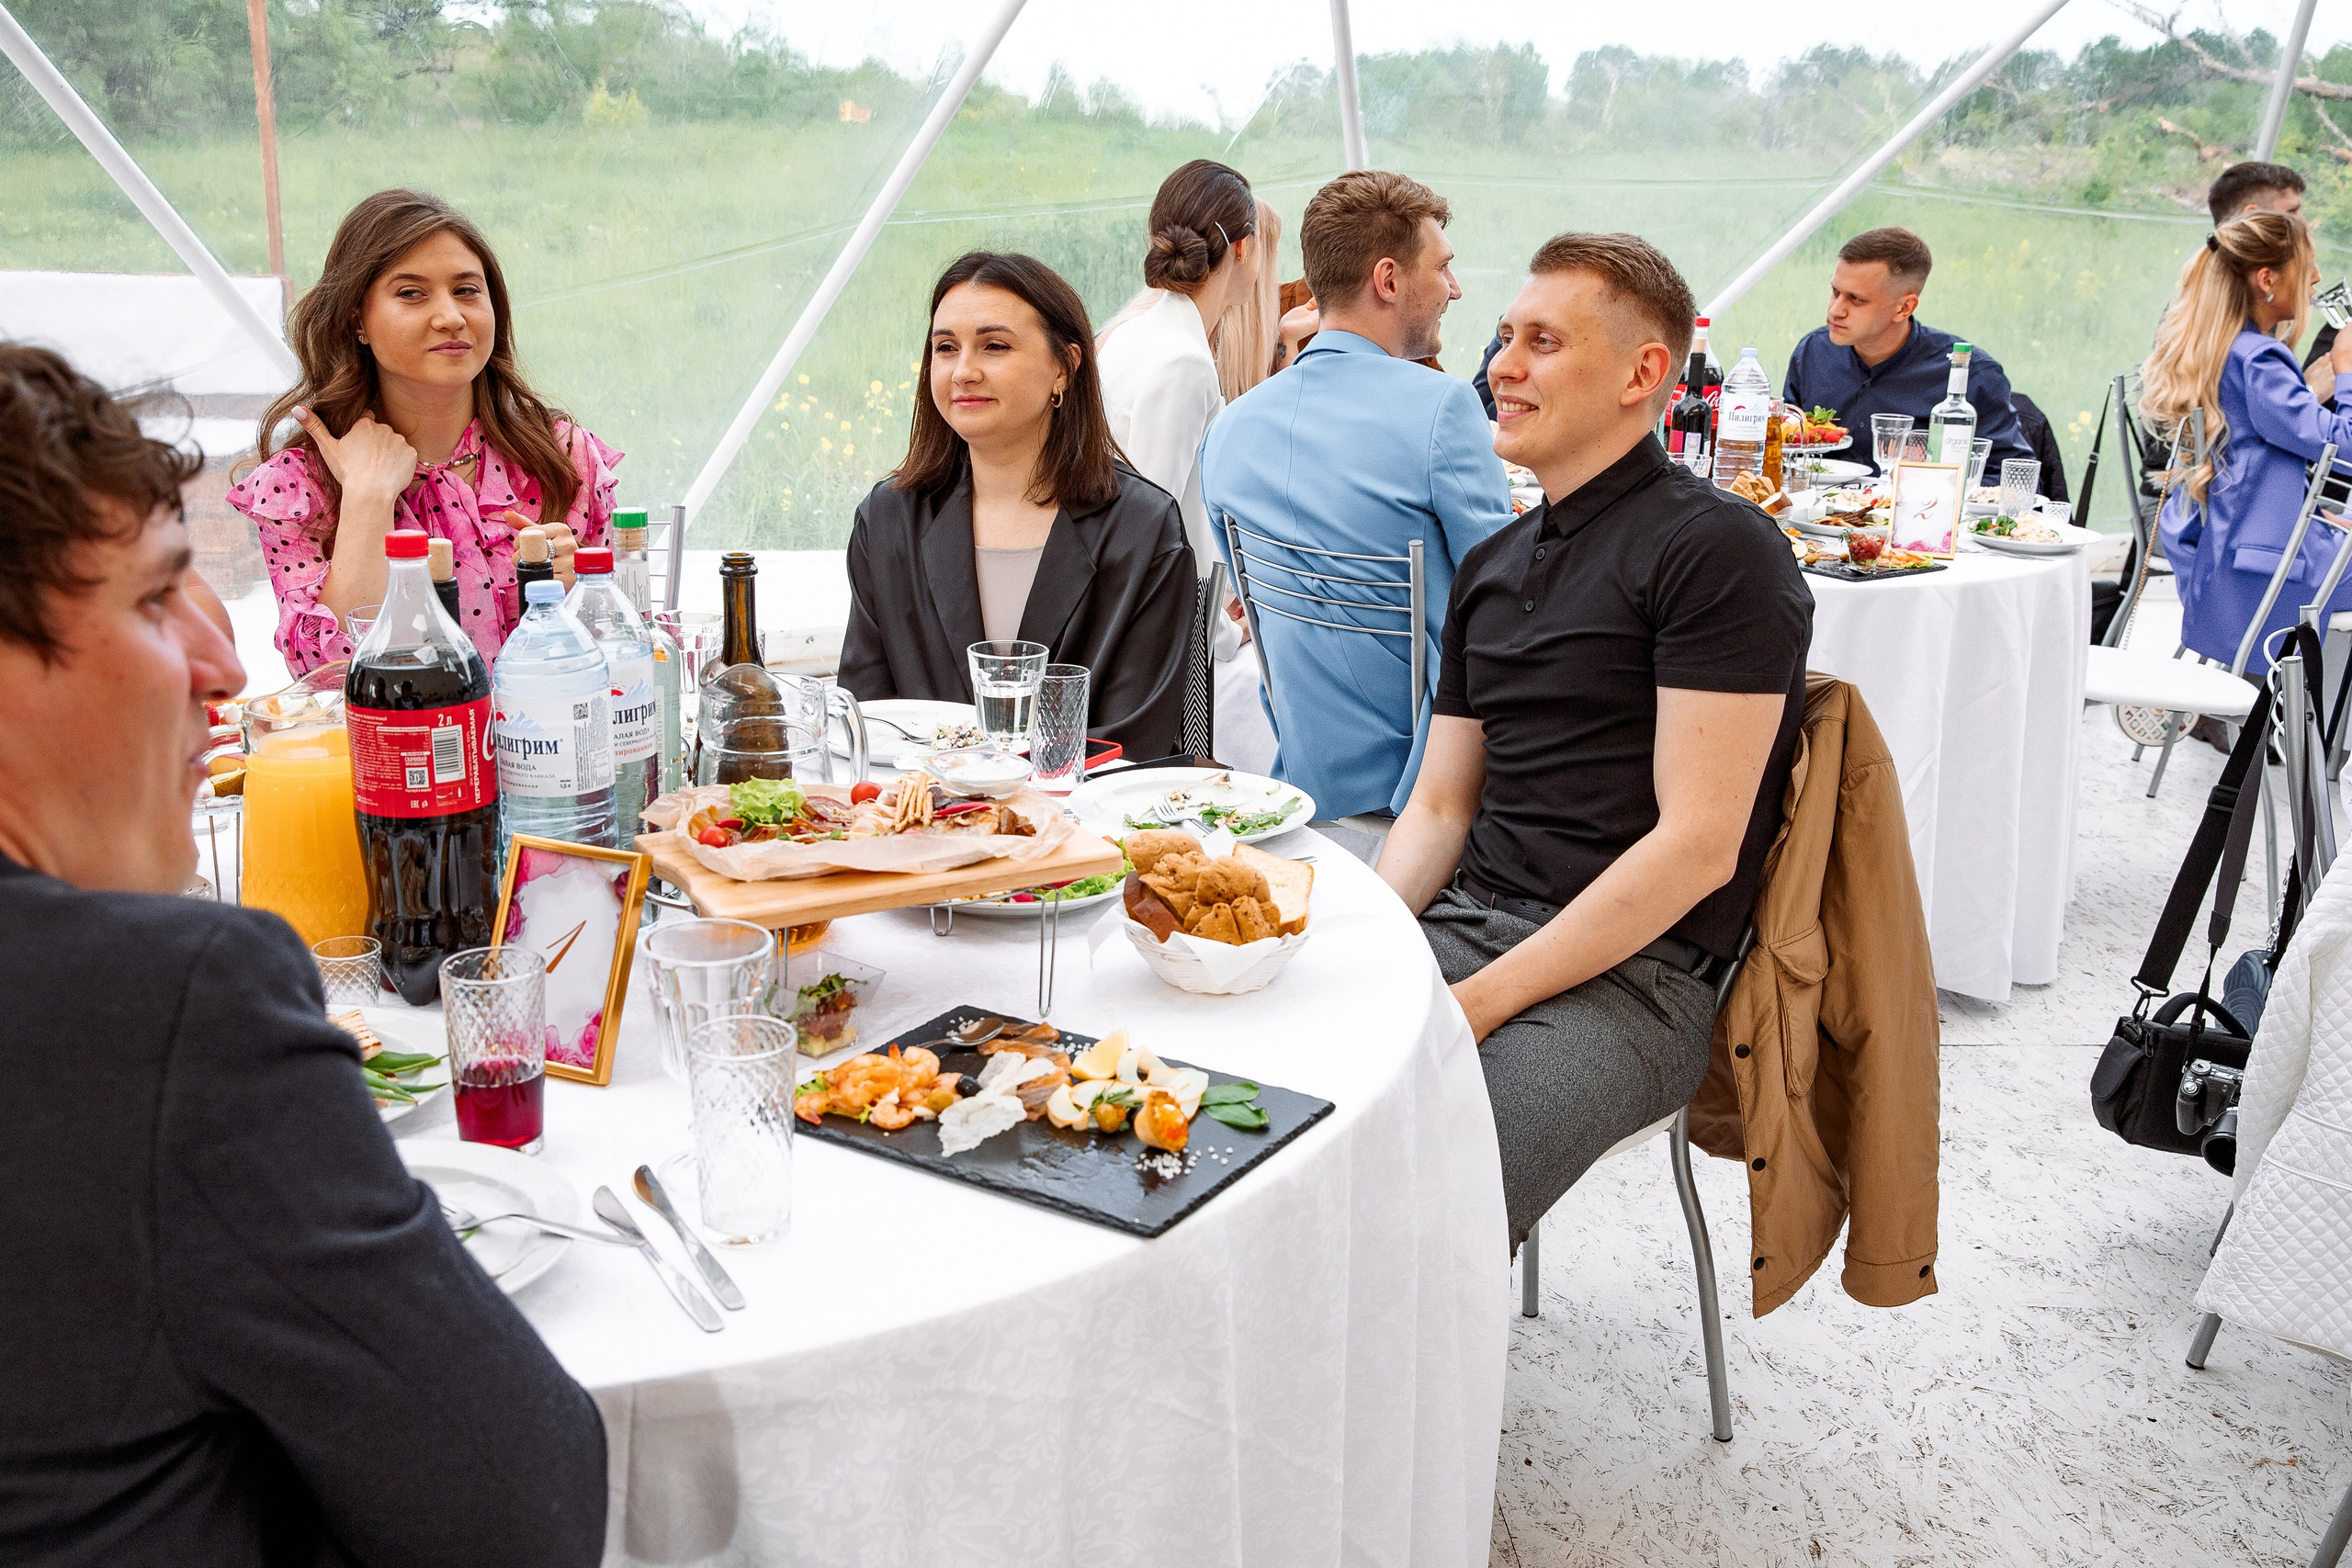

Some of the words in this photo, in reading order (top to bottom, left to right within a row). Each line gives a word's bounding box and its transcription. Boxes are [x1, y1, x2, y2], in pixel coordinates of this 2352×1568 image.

[1913, 495, 1939, 520] 2
[437, 714, 445, 727] 2
[613, 699, 656, 726] лигри
[496, 733, 559, 761] илигрим
